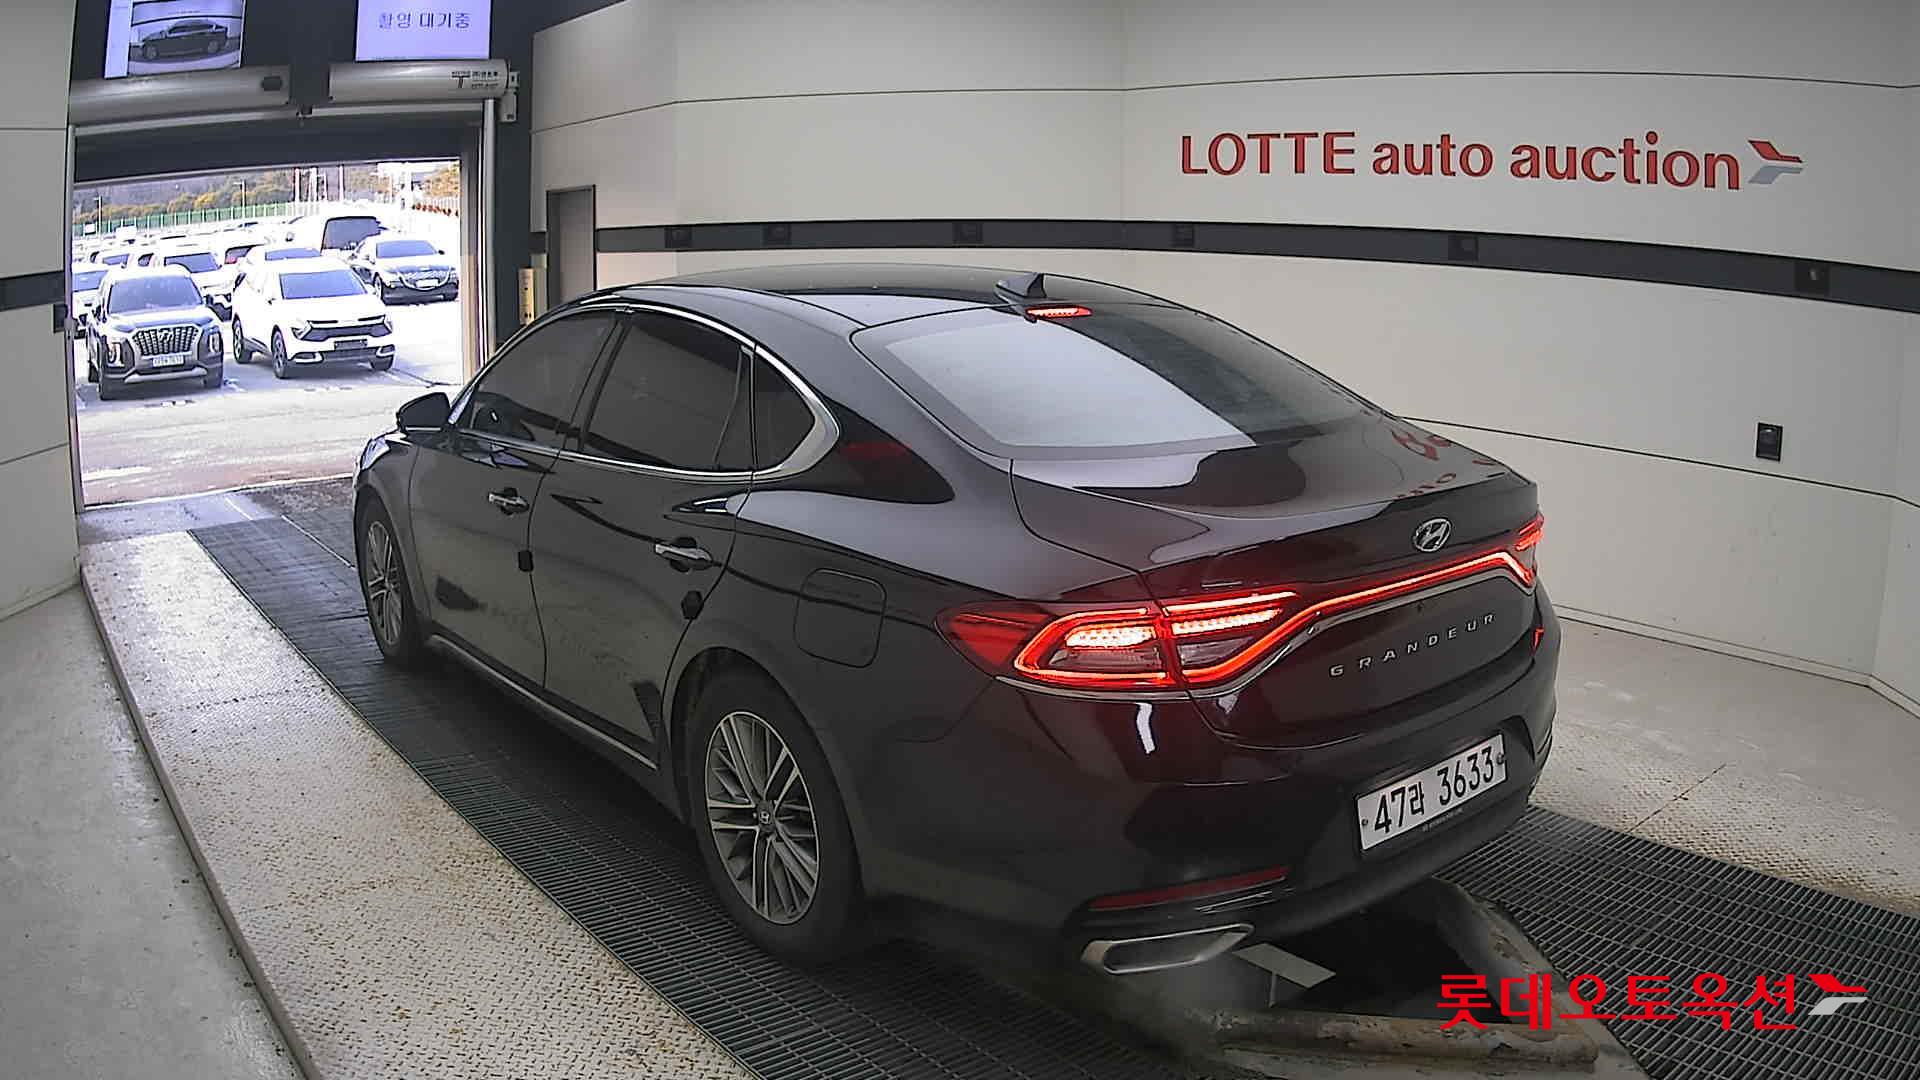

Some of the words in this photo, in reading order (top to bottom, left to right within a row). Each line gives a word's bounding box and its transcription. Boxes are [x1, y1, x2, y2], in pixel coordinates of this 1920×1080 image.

[419, 12, 471, 29] 대기중
[1182, 132, 1355, 175] LOTTE
[1372, 135, 1493, 176] auto
[1510, 131, 1741, 190] auction
[1329, 614, 1495, 677] GRANDEUR
[1373, 781, 1425, 834] 47라
[1436, 745, 1495, 805] 3633
